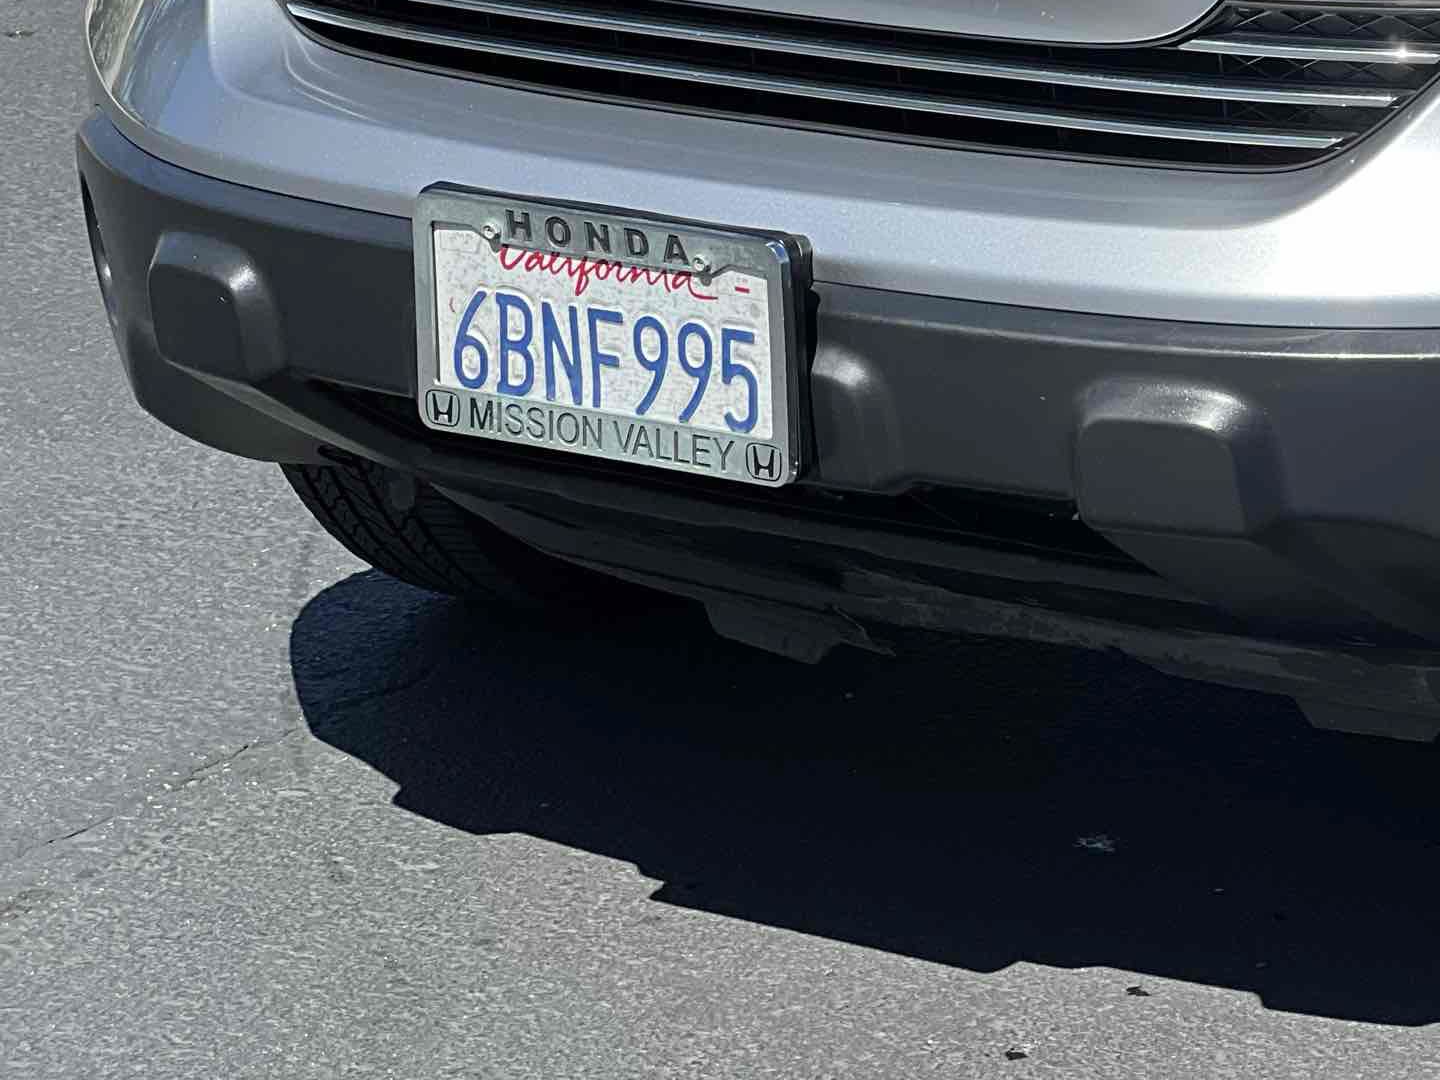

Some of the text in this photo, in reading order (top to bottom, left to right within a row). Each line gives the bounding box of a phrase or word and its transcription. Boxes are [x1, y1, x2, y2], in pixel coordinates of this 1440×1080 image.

[505, 209, 690, 265] HONDA
[453, 290, 759, 433] 6BNF995
[470, 397, 602, 450] MISSION
[613, 420, 735, 470] VALLEY
